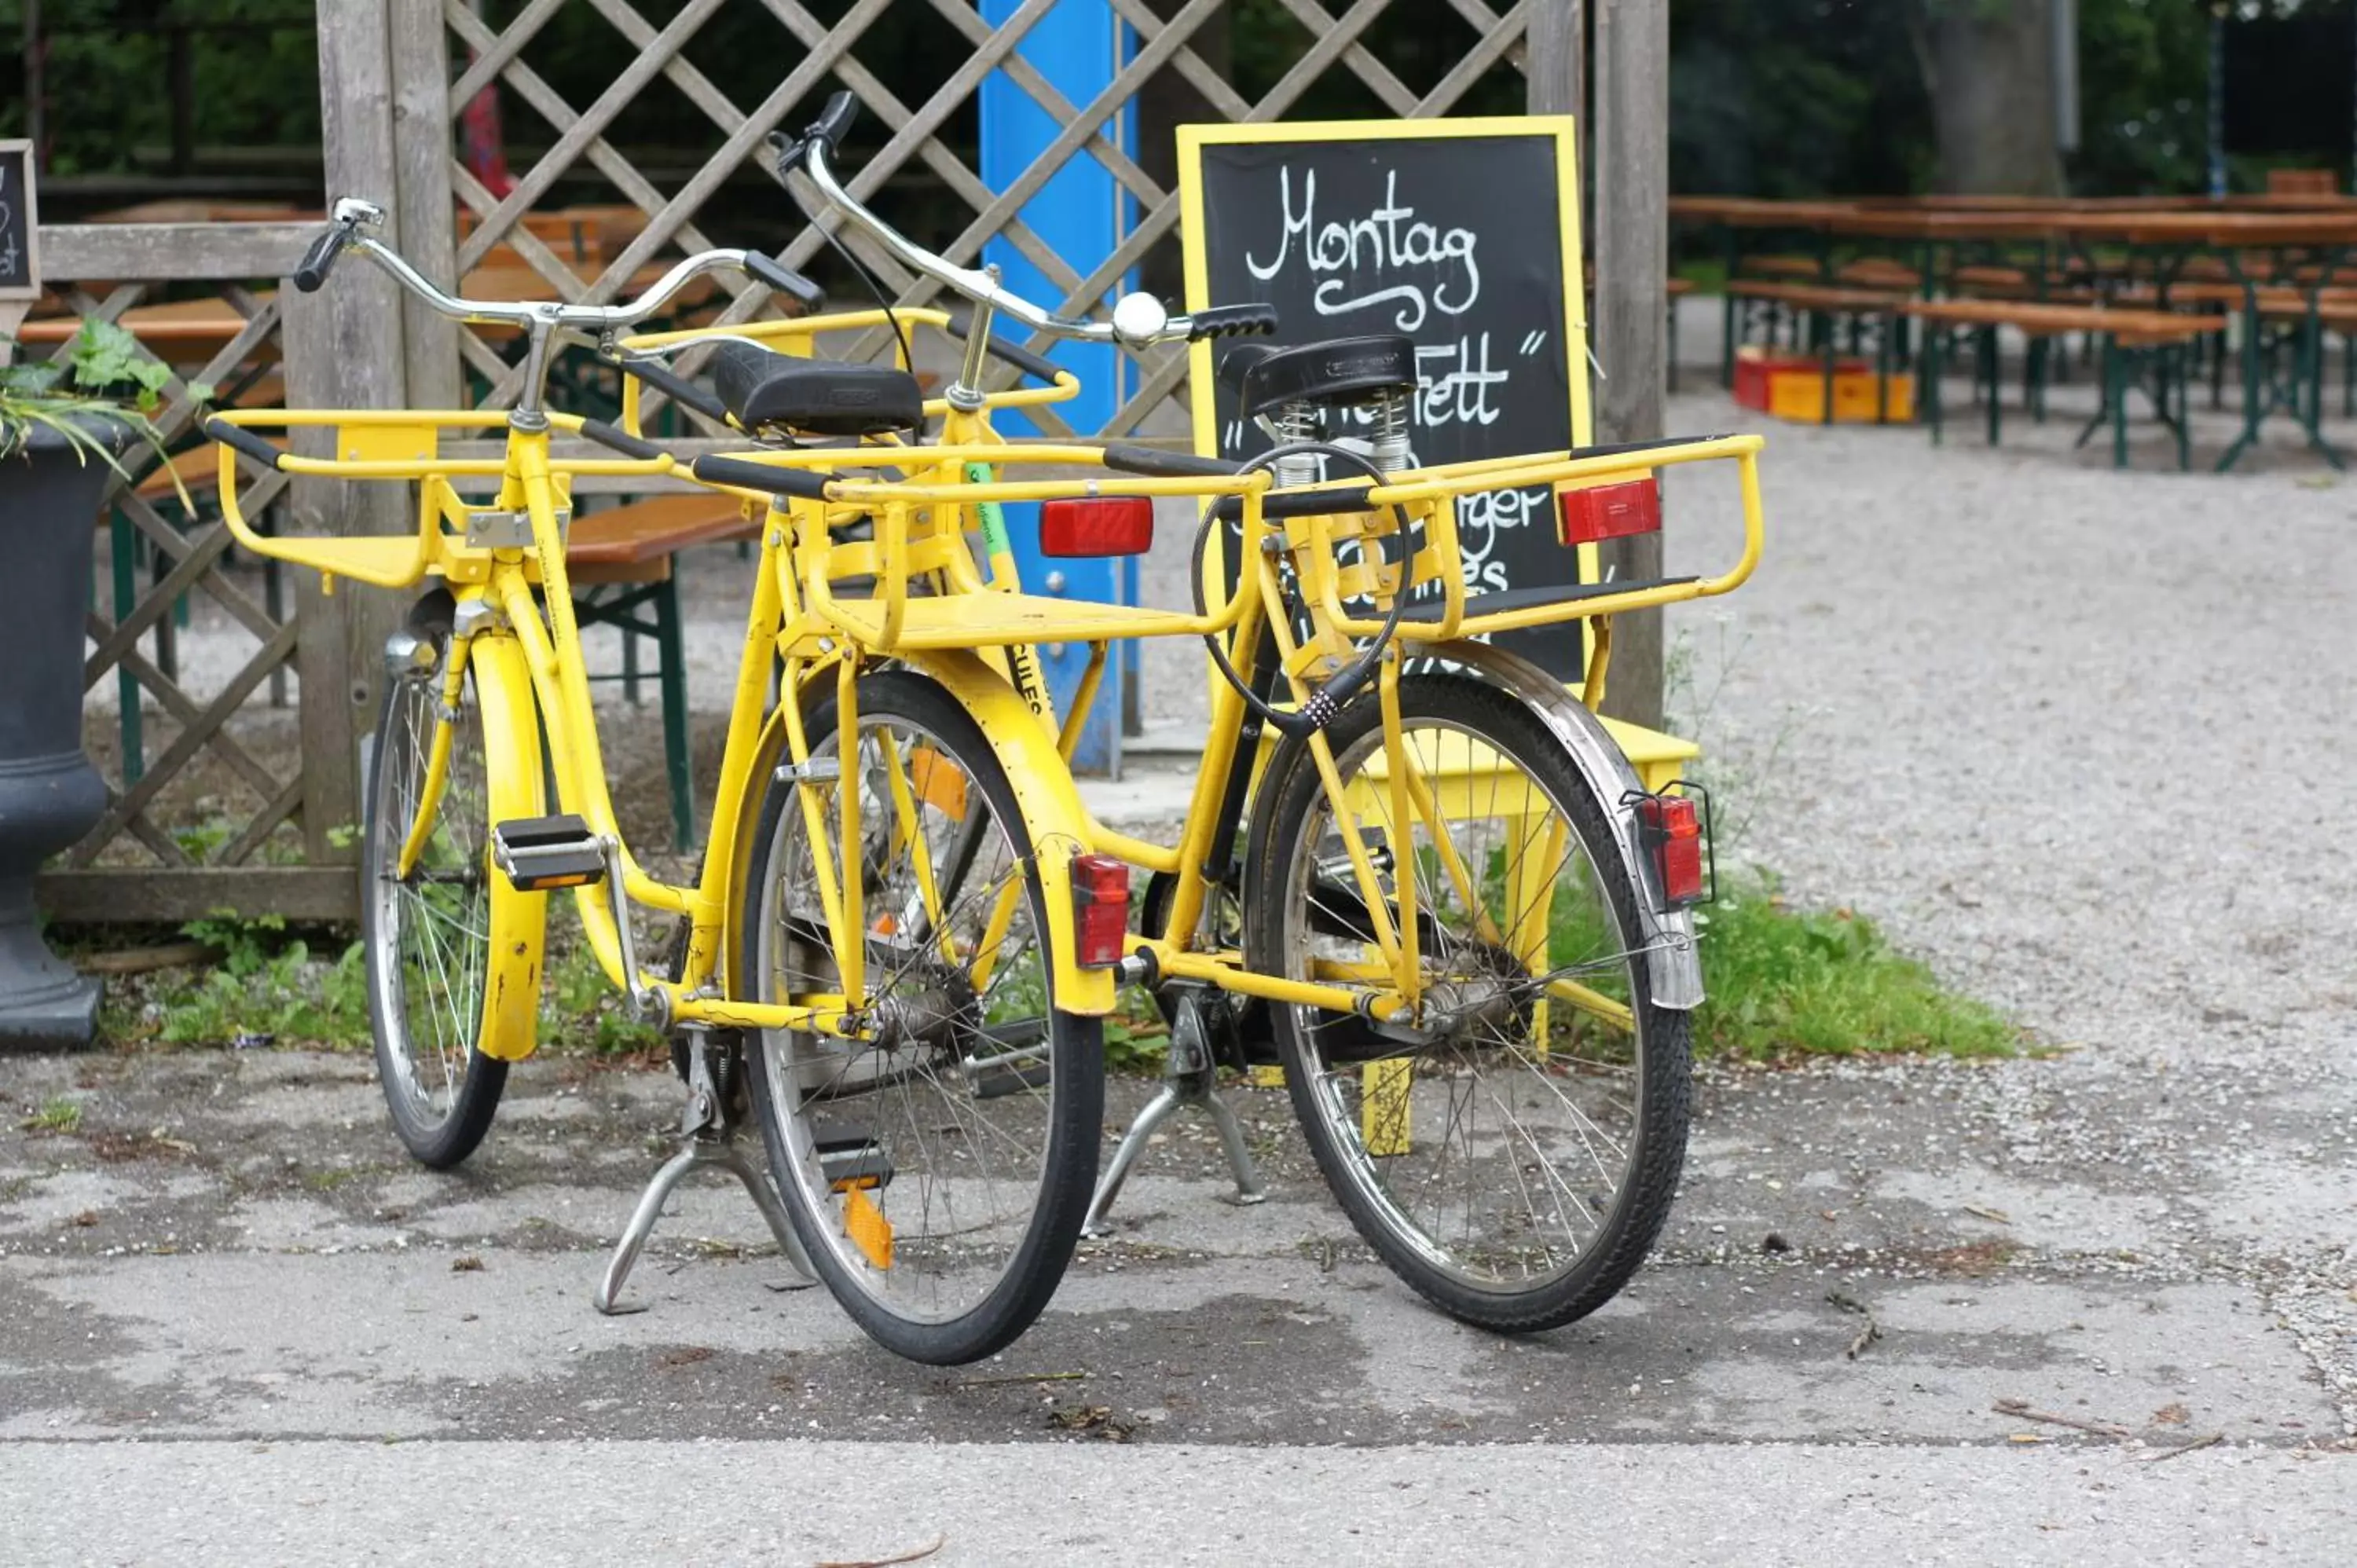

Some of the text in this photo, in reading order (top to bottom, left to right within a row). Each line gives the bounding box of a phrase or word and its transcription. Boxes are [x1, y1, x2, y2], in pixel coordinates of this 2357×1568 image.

[1245, 165, 1479, 315] Montag
[1455, 488, 1549, 563] rger
[1014, 643, 1043, 716] CULES
